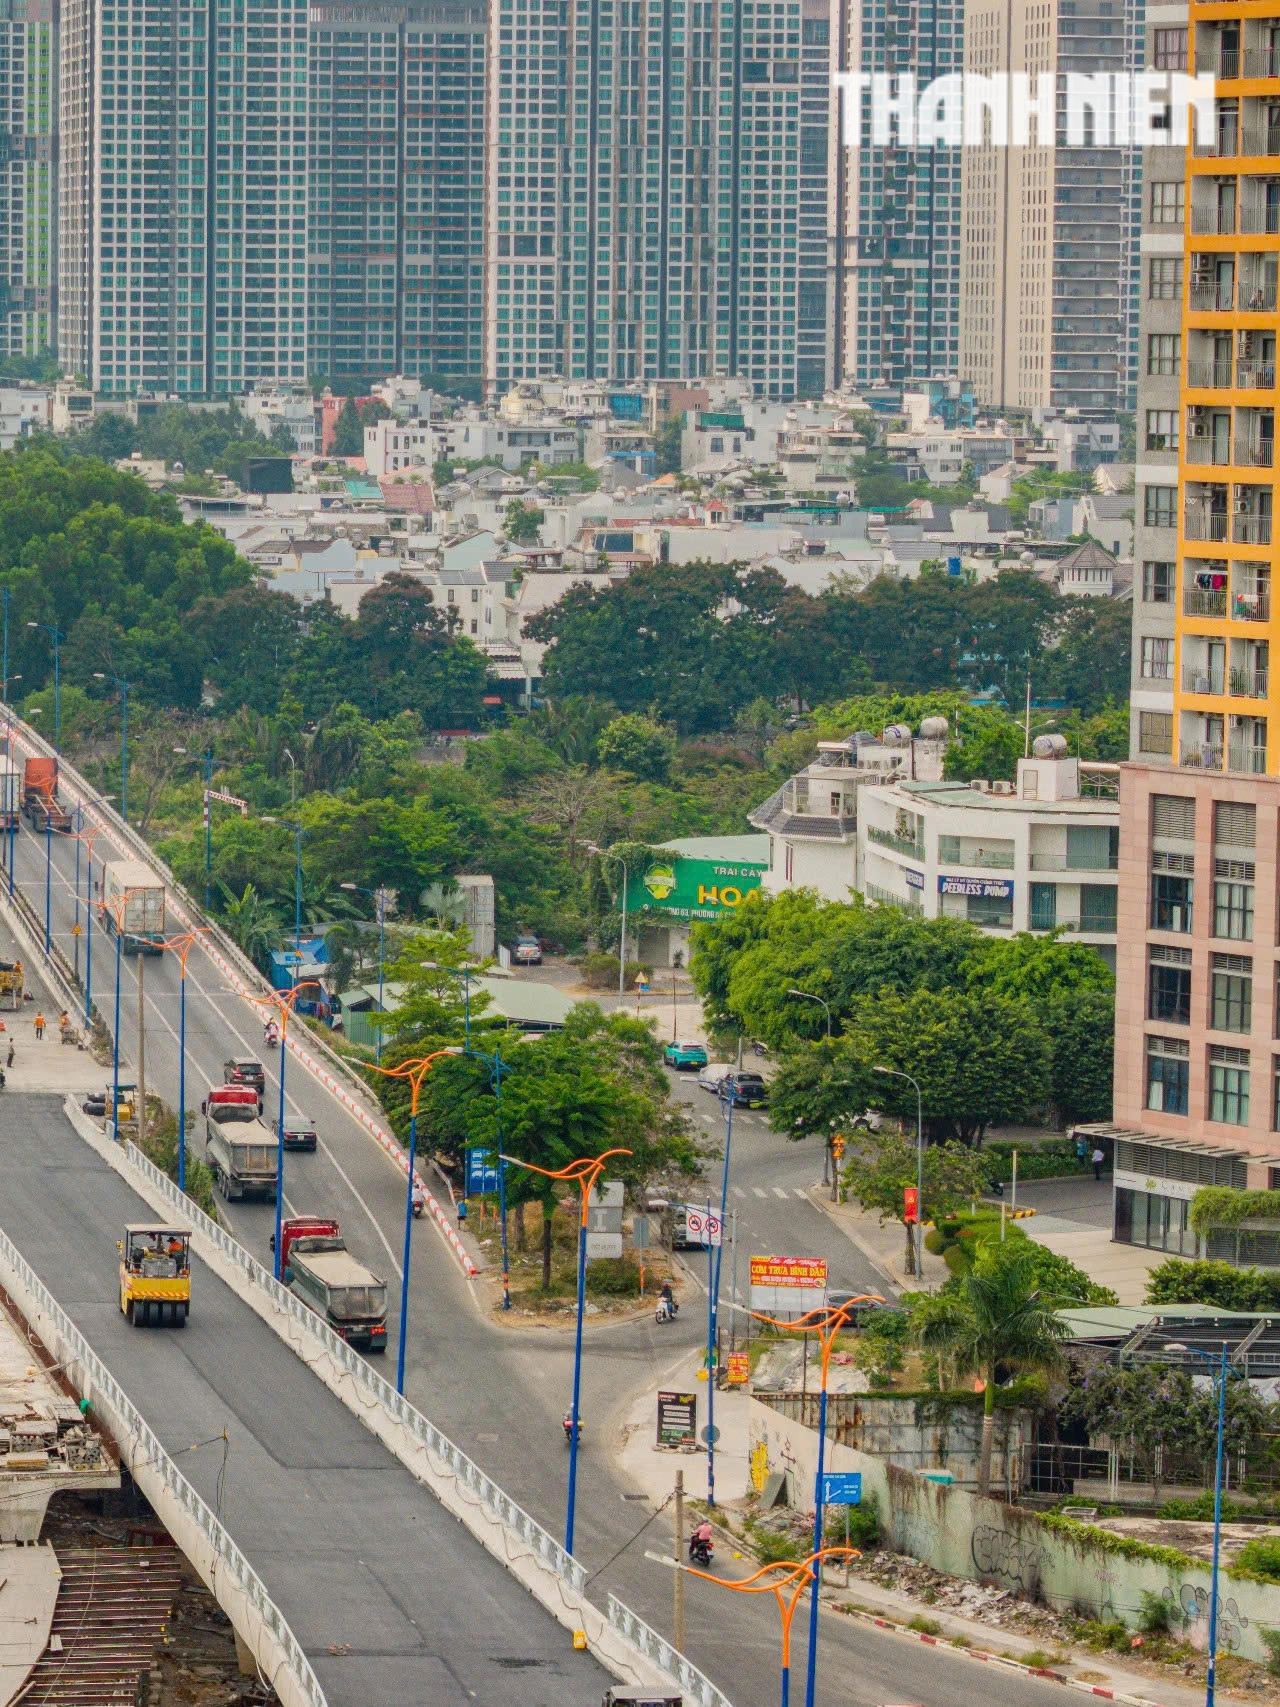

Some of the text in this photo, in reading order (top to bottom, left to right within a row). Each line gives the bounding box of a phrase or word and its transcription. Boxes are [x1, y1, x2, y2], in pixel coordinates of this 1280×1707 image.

[713, 864, 738, 876] TRÁI
[942, 882, 1010, 897] PEERLESS PUMP
[751, 1264, 825, 1277] CƠM TRƯA BÌNH DÂN
